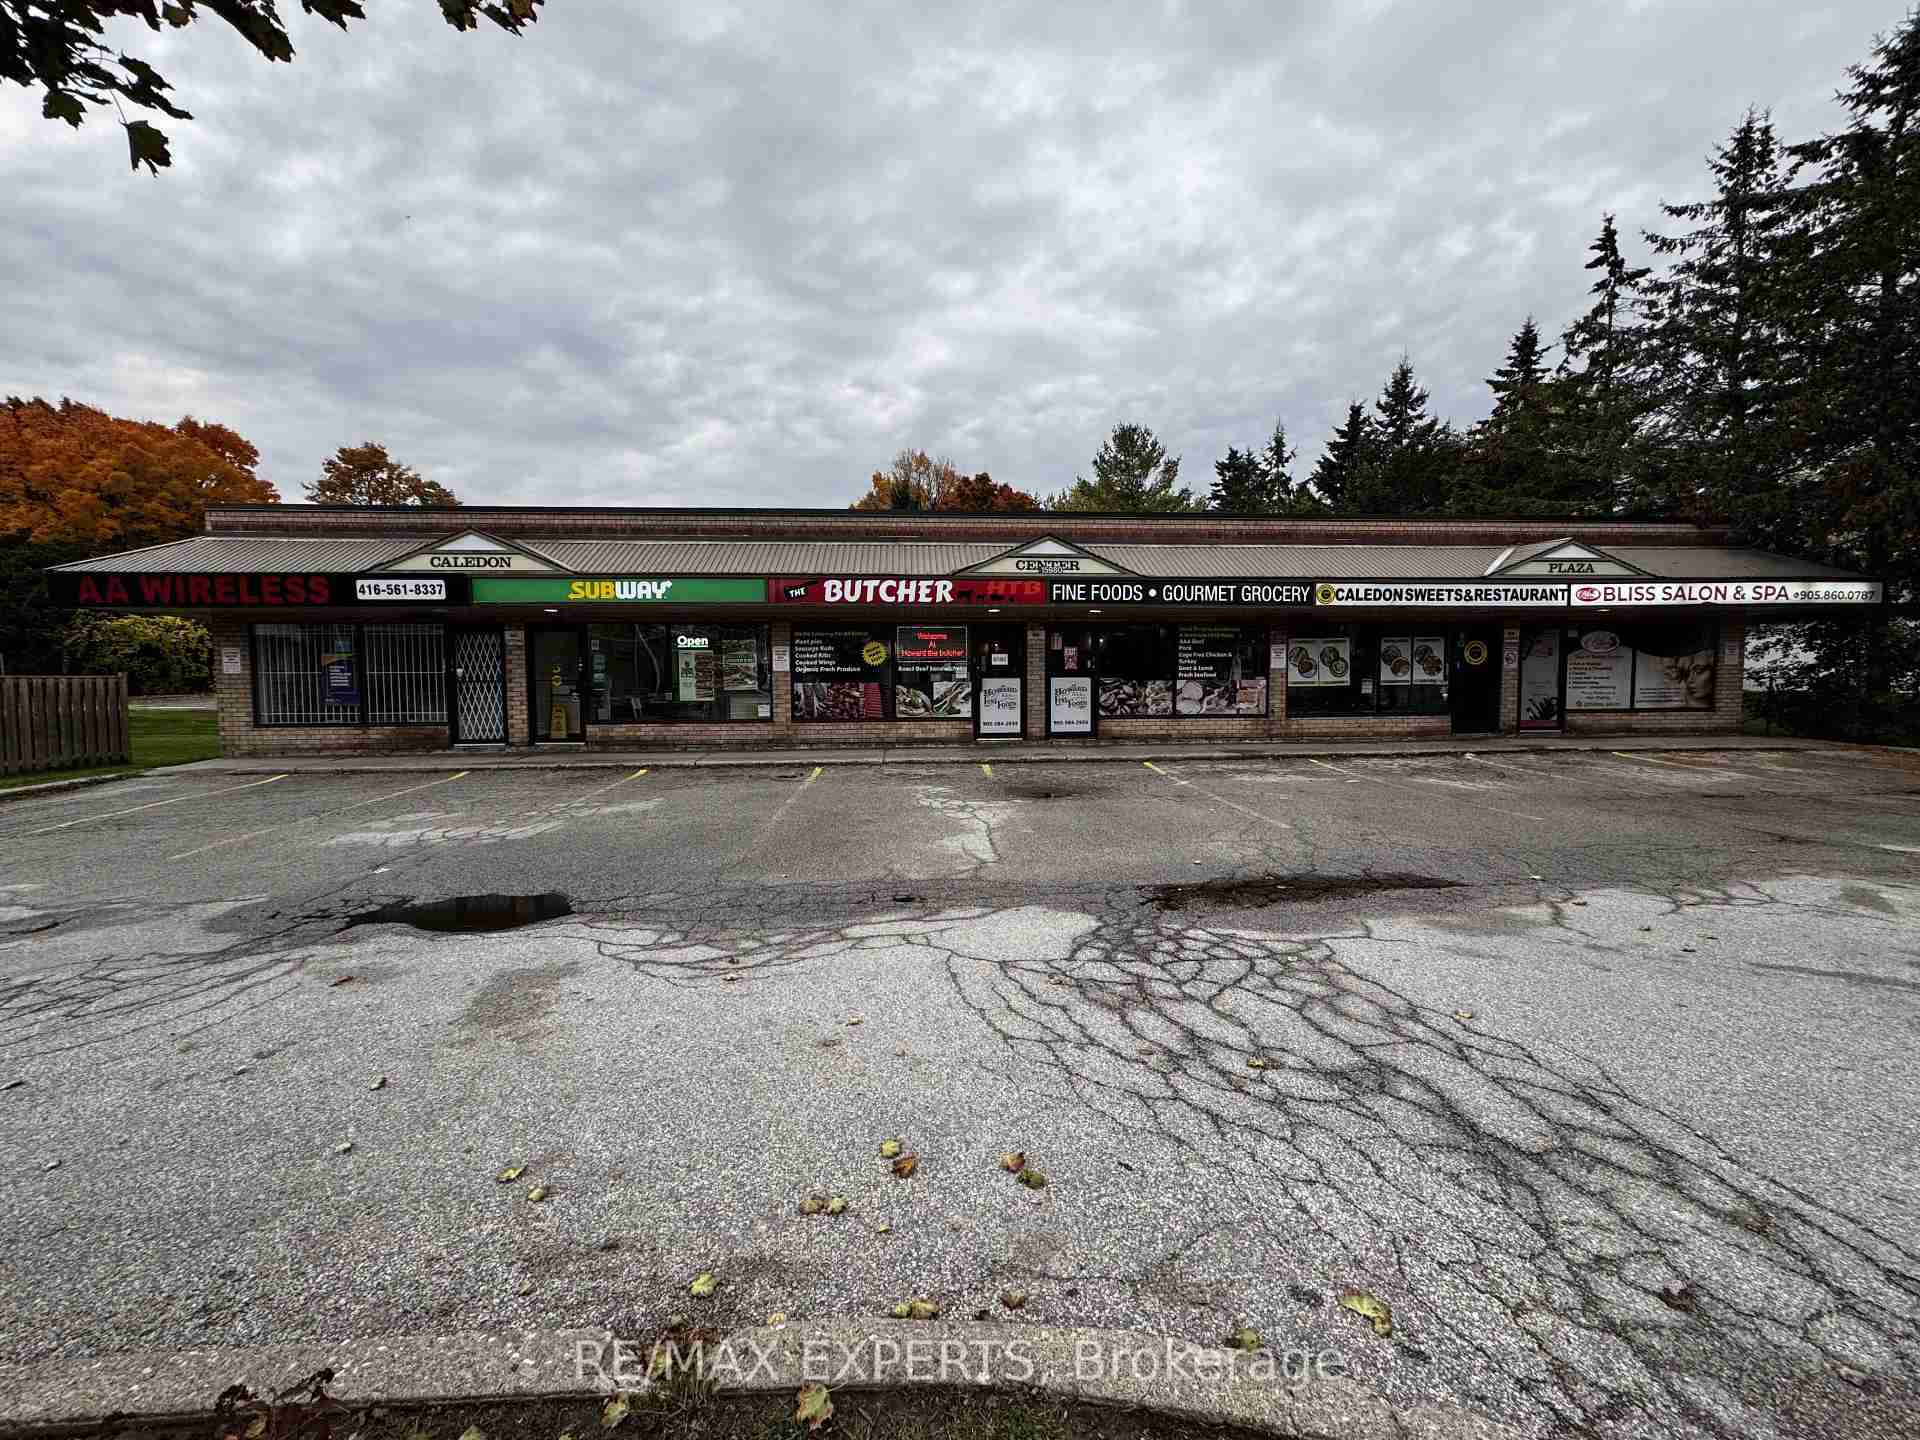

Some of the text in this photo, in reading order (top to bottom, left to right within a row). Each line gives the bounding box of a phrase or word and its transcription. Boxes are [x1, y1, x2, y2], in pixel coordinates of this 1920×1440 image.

[430, 555, 511, 569] CALEDON
[1016, 560, 1080, 571] CENTER
[1548, 562, 1595, 574] PLAZA
[80, 575, 330, 605] AA WIRELESS
[358, 583, 443, 596] 416-561-8337
[568, 580, 672, 600] SUBWAY
[788, 579, 954, 603] THE BUTCHER
[1053, 584, 1310, 602] FINE FOODS GOURMET GROCERY
[1603, 586, 1656, 602] BLISS
[1663, 586, 1727, 601] SALON
[1733, 586, 1746, 600] &
[1752, 586, 1790, 600] SPA
[677, 635, 709, 647] Open
